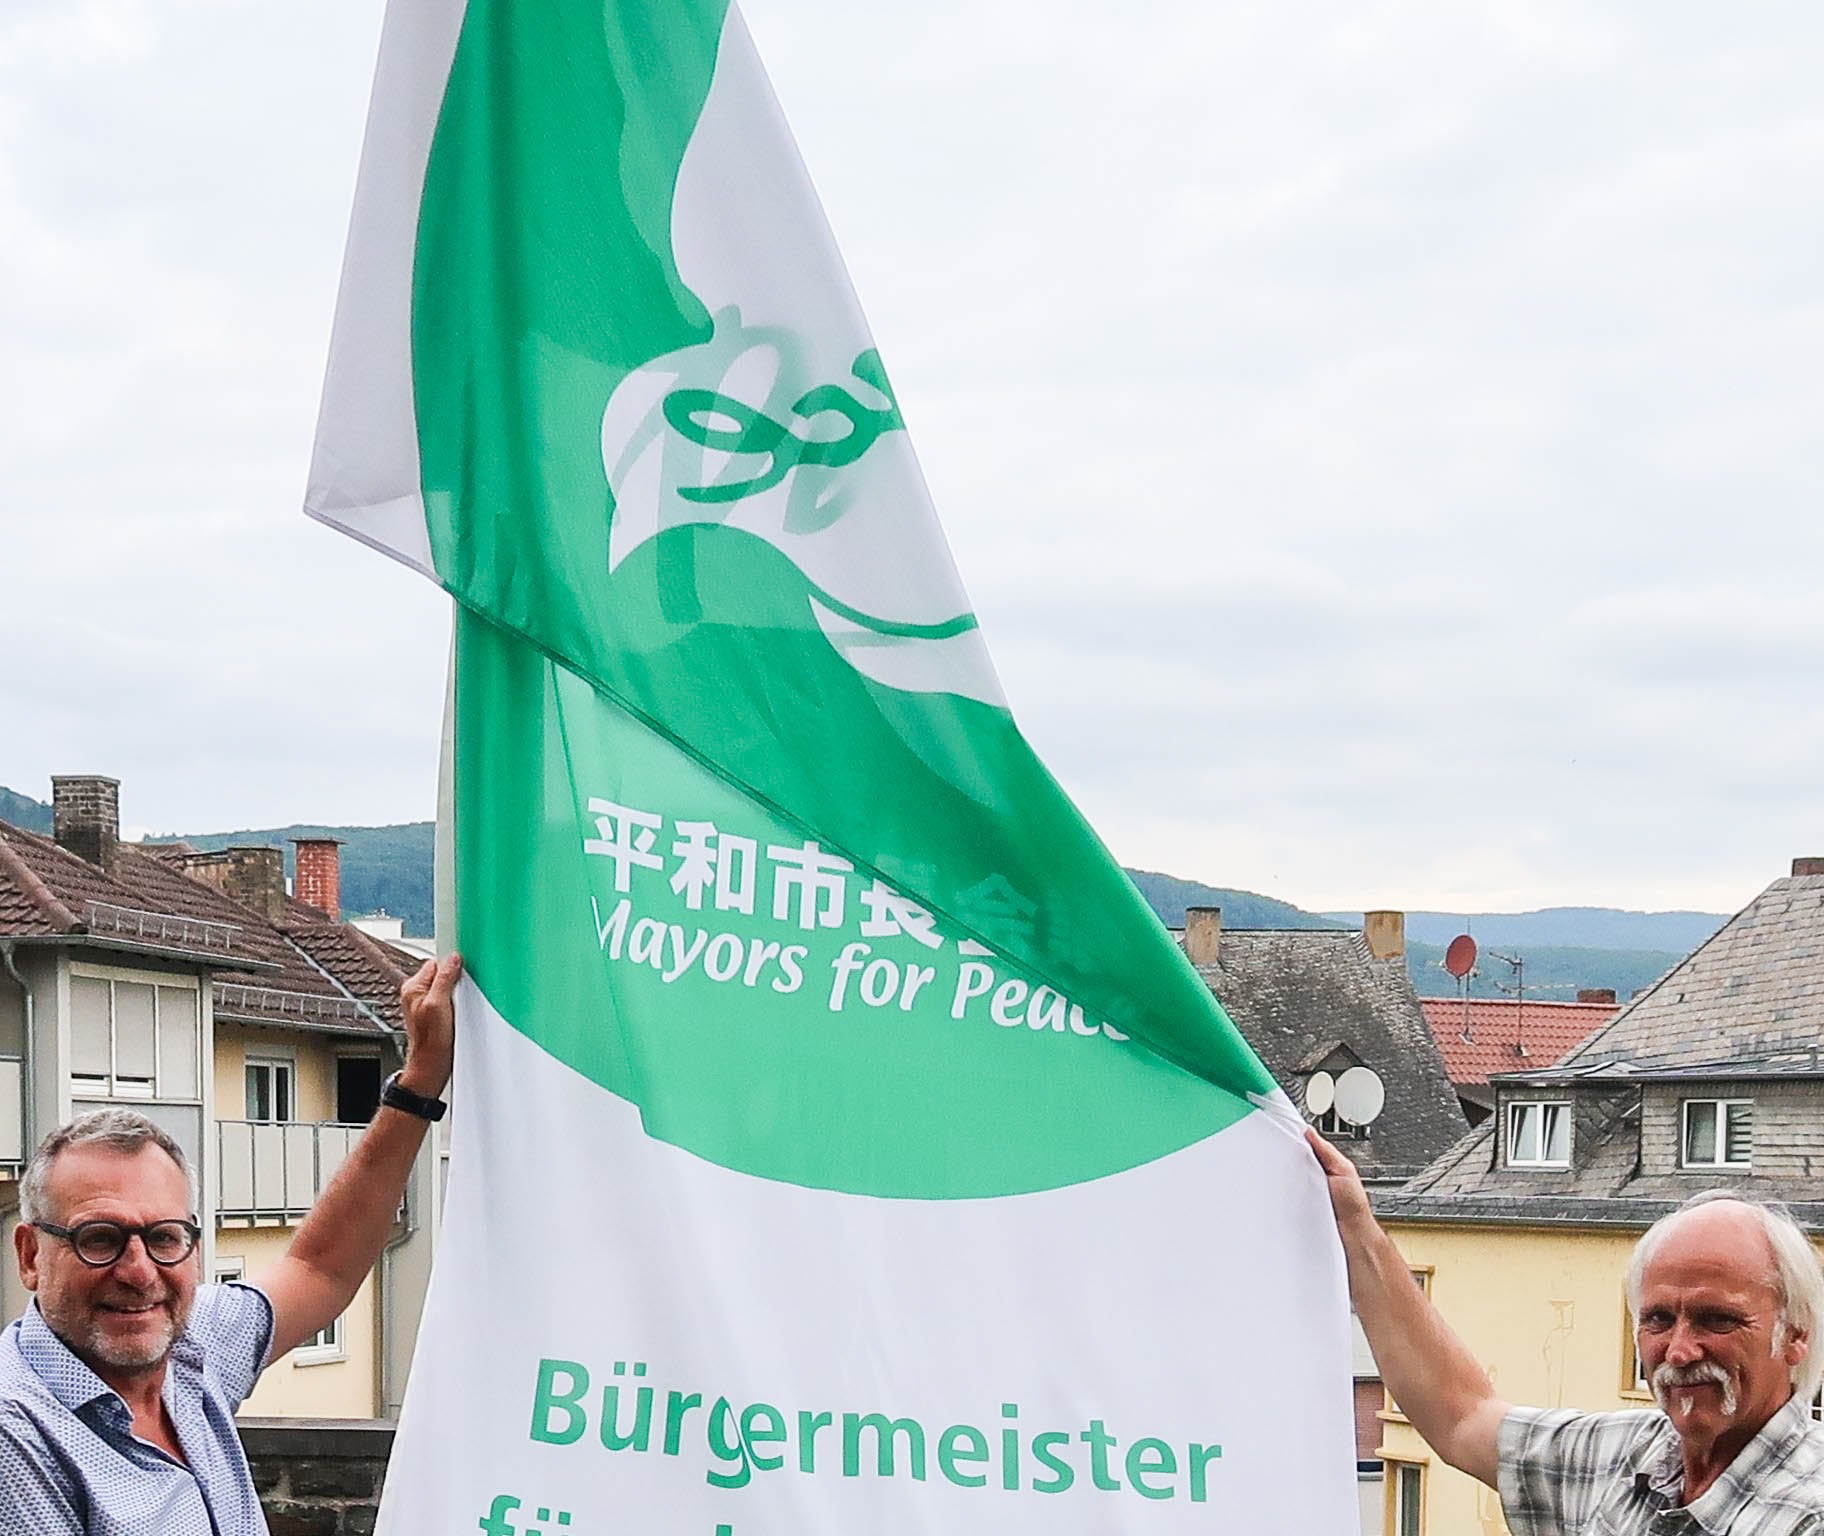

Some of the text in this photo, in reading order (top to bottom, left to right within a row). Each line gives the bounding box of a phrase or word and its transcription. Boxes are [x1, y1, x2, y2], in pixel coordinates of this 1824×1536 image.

[583, 796, 999, 958] 平和市長
[590, 894, 808, 993] Mayors
[828, 942, 936, 1012] for
[528, 1357, 1223, 1503] Bürgermeister
